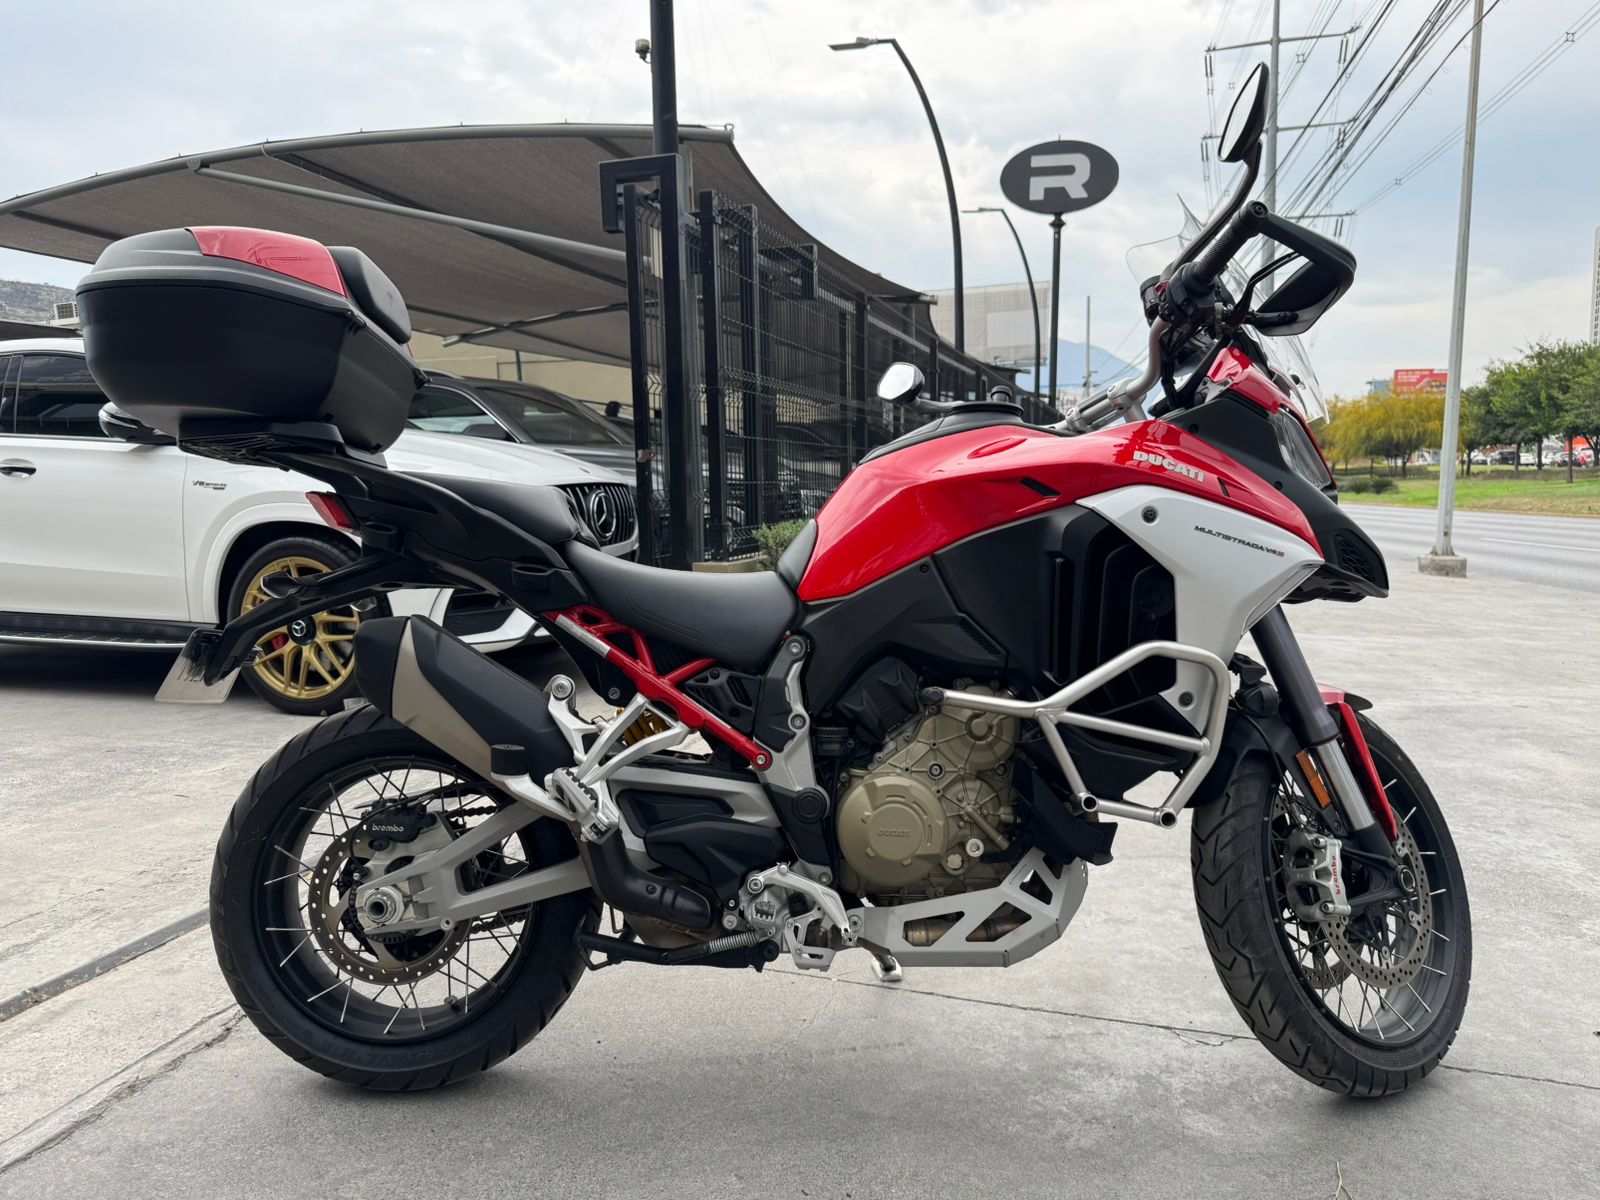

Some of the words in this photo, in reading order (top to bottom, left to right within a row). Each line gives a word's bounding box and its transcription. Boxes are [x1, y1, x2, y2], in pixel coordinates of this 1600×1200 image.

[1028, 153, 1091, 201] R
[1133, 450, 1204, 482] DUCATI
[372, 823, 404, 832] brembo
[1330, 855, 1342, 896] brembo
